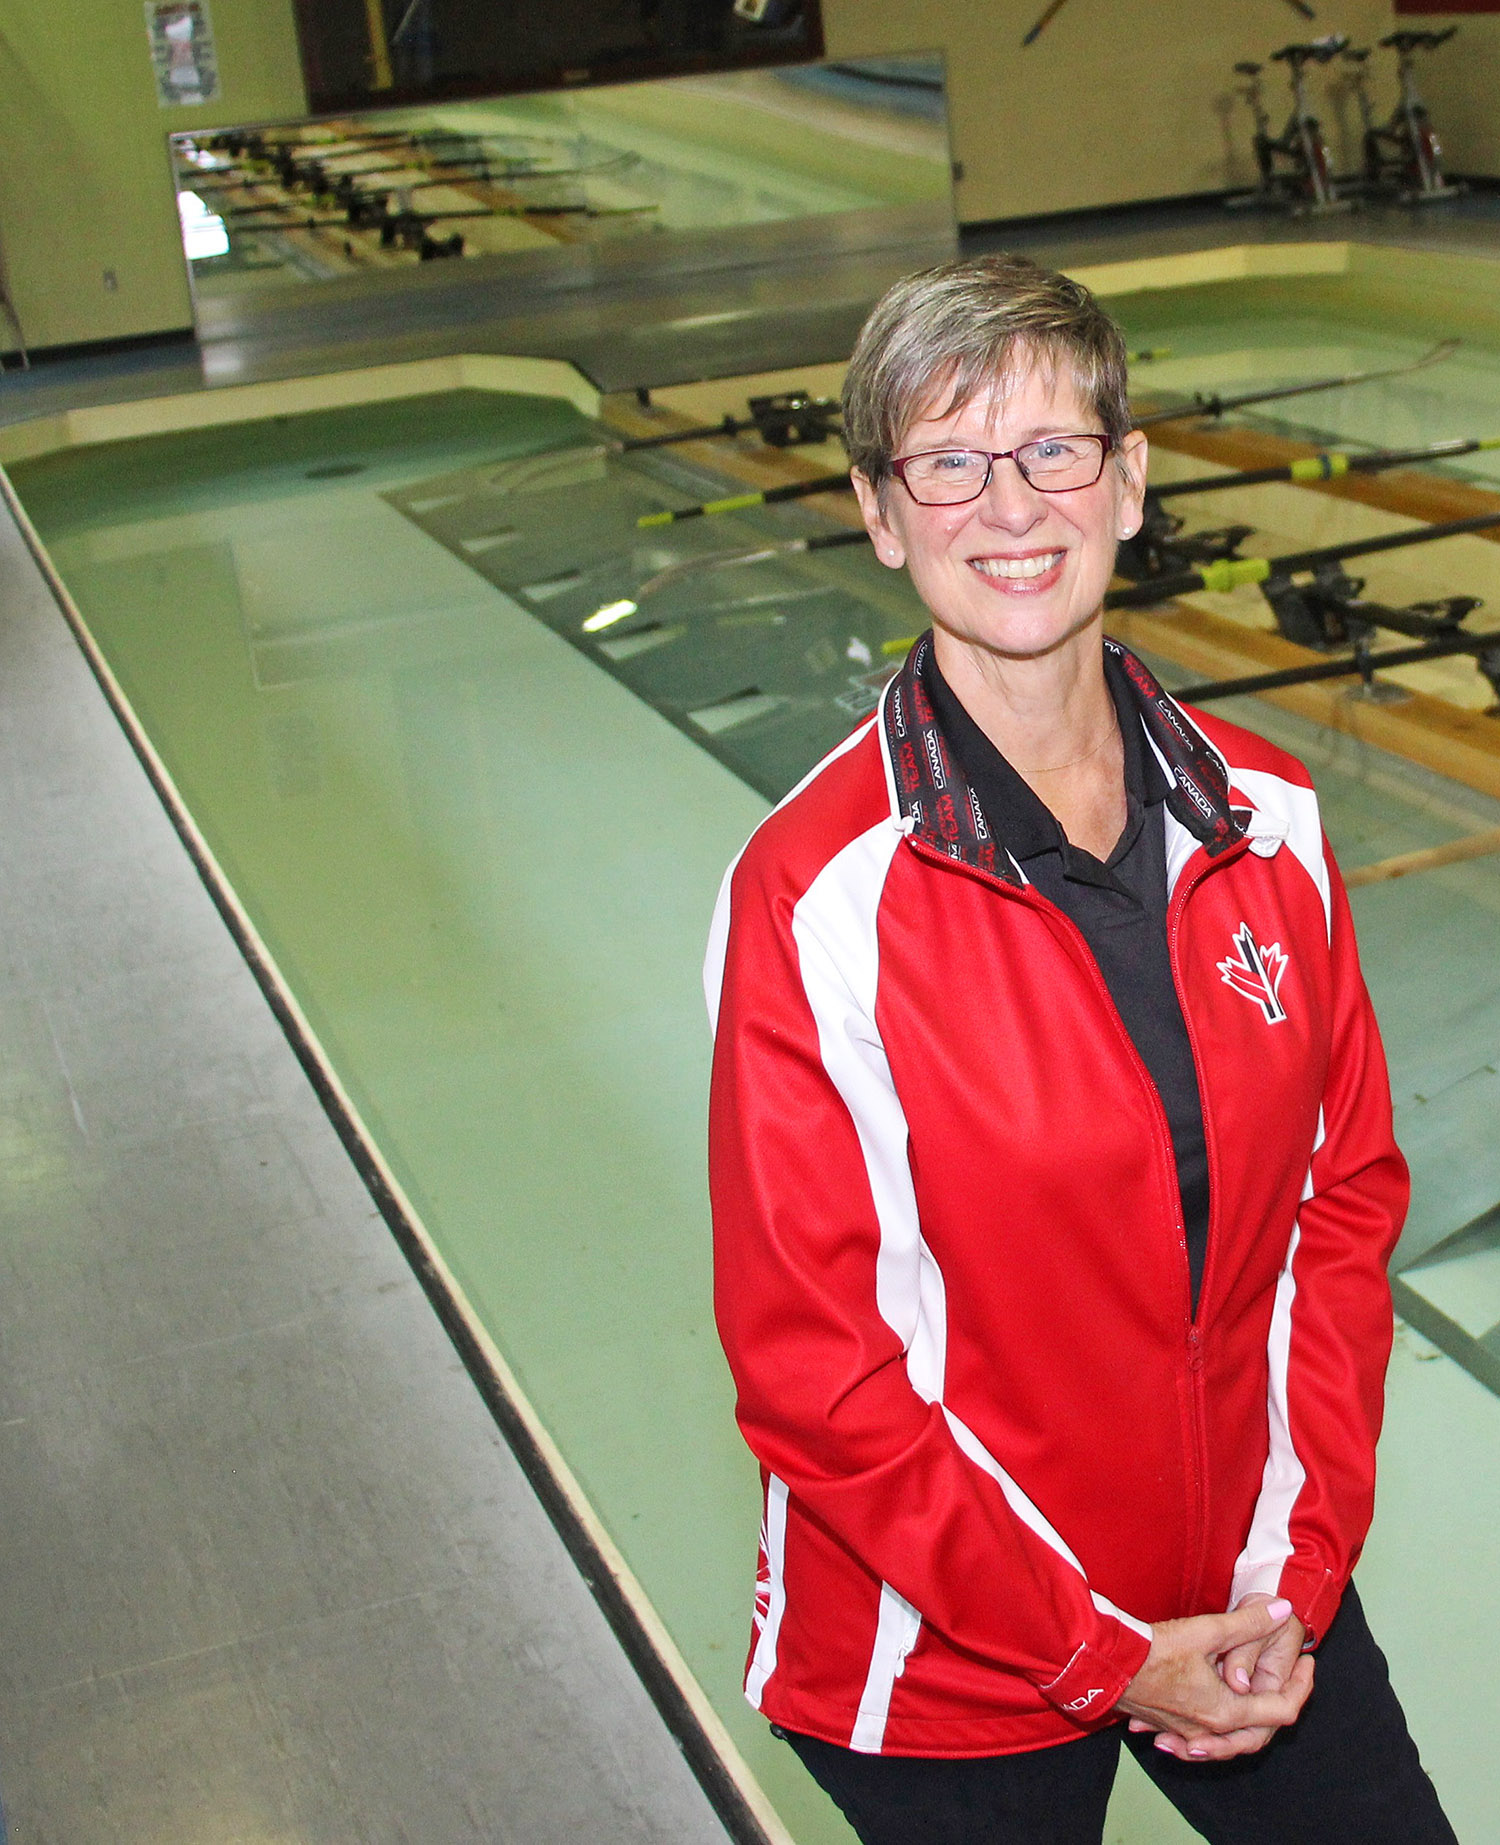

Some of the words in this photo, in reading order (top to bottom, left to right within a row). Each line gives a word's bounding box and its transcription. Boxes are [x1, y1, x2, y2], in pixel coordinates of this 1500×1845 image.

[893, 685, 906, 738] CANADA
[1158, 699, 1194, 752] CANADA
[905, 741, 921, 792] TEAM
[926, 729, 944, 790] CANADA
[941, 794, 959, 841] TEAM
[1174, 767, 1212, 818] CANADA
